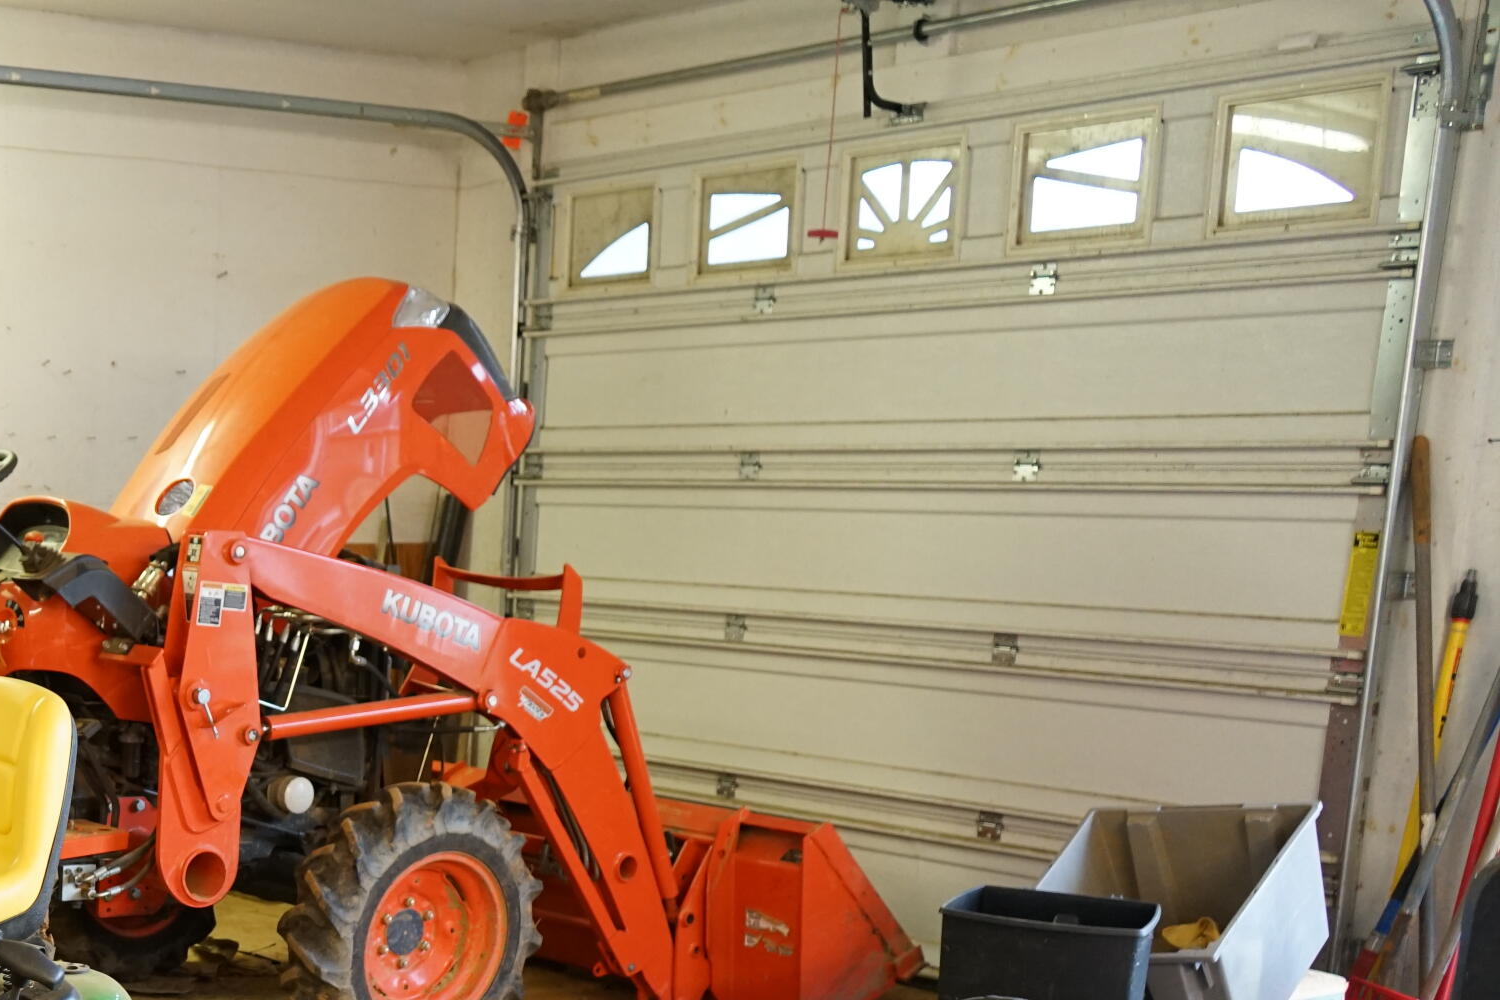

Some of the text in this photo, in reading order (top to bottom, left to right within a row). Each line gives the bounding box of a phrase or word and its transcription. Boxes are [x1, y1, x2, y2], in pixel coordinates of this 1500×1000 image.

[347, 341, 411, 434] L3301
[382, 588, 480, 650] KUBOTA
[509, 647, 584, 712] LA525
